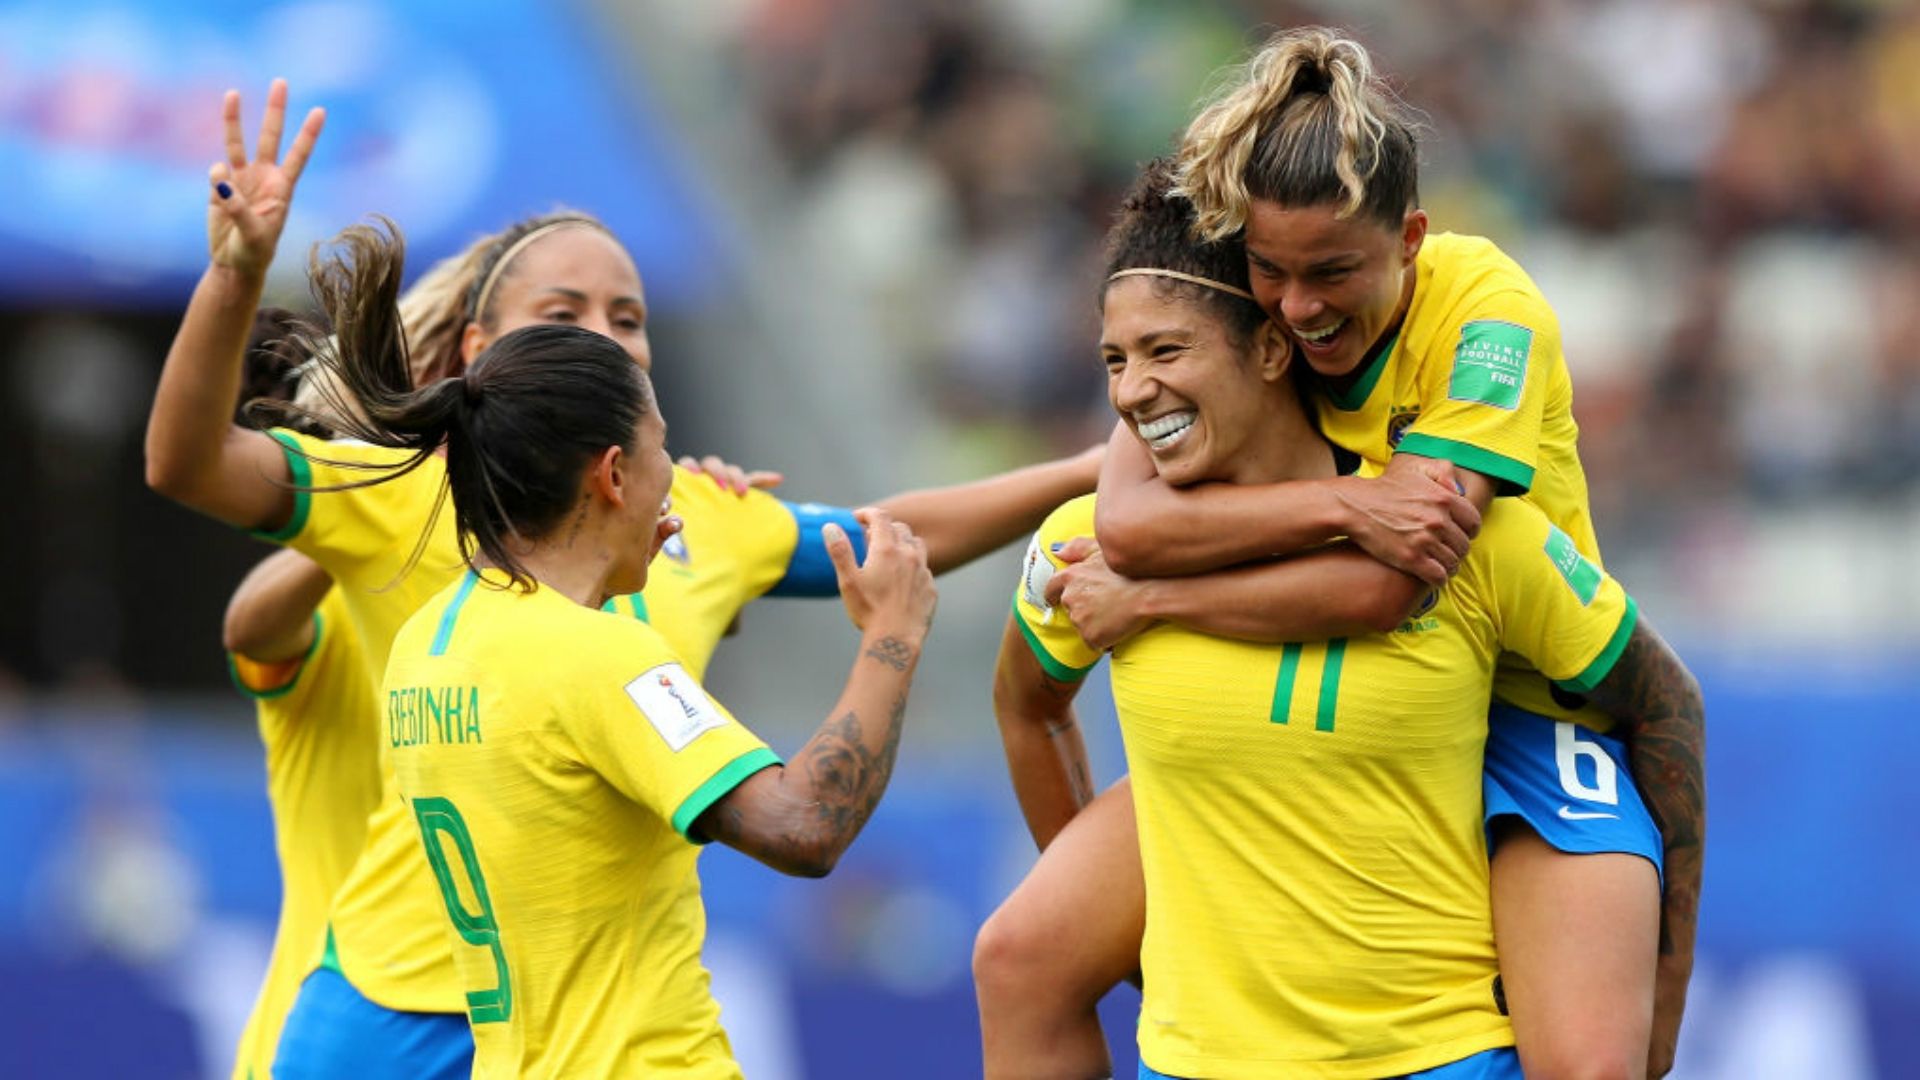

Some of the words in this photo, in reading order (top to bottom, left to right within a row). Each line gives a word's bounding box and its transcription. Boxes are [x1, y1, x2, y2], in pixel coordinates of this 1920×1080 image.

[1490, 371, 1516, 386] FIFA
[389, 687, 482, 748] DEBINHA
[1555, 721, 1618, 806] 6
[412, 797, 512, 1024] 9
